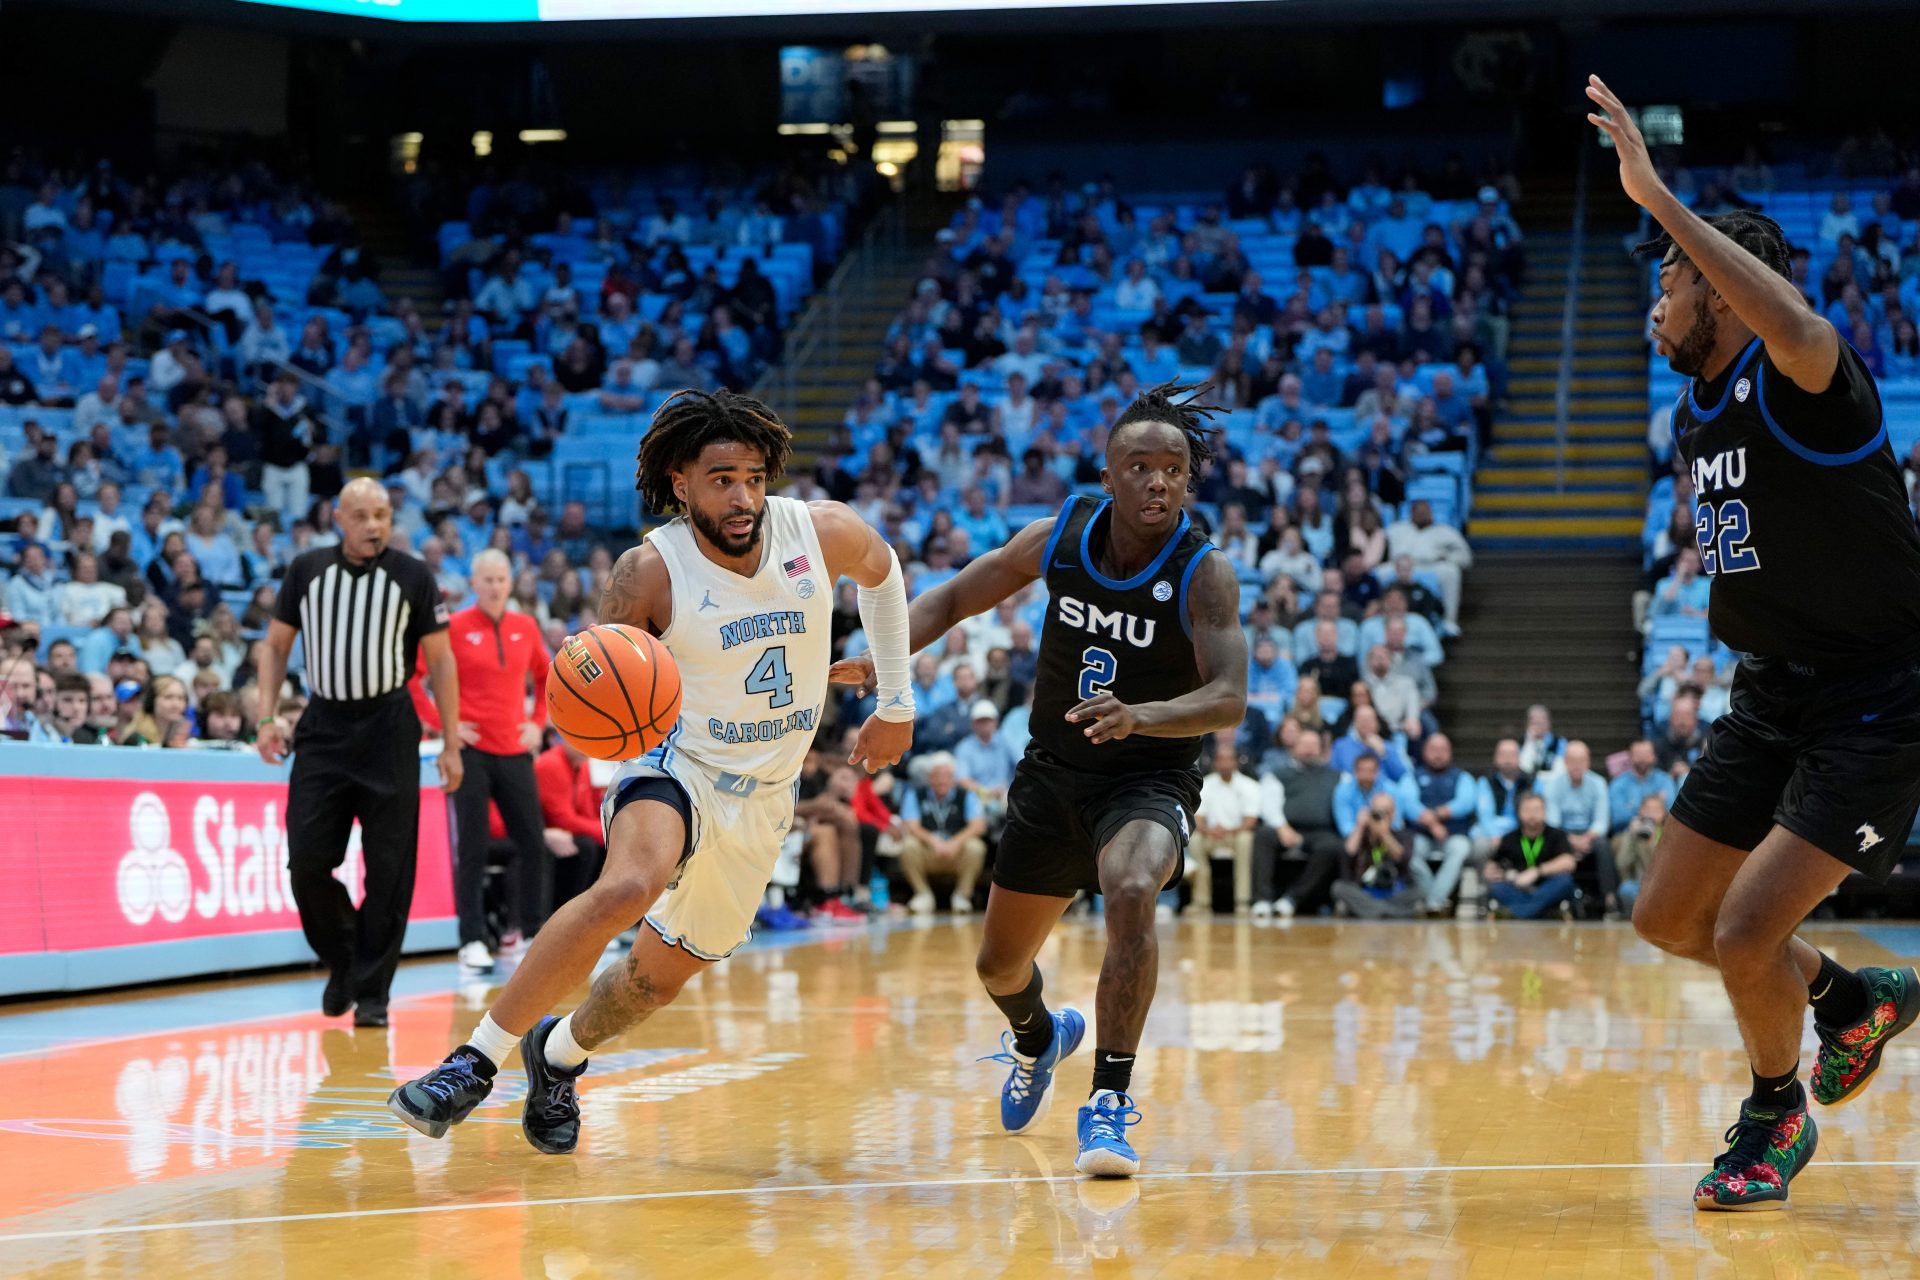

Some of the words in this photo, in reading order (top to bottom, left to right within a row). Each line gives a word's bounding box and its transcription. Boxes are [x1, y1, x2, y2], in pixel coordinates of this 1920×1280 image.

[1692, 448, 1746, 498] MU
[1696, 499, 1761, 576] 22
[720, 611, 807, 650] NORTH
[1059, 596, 1156, 648] SMU
[745, 646, 793, 709] 4
[1078, 646, 1117, 701] 2
